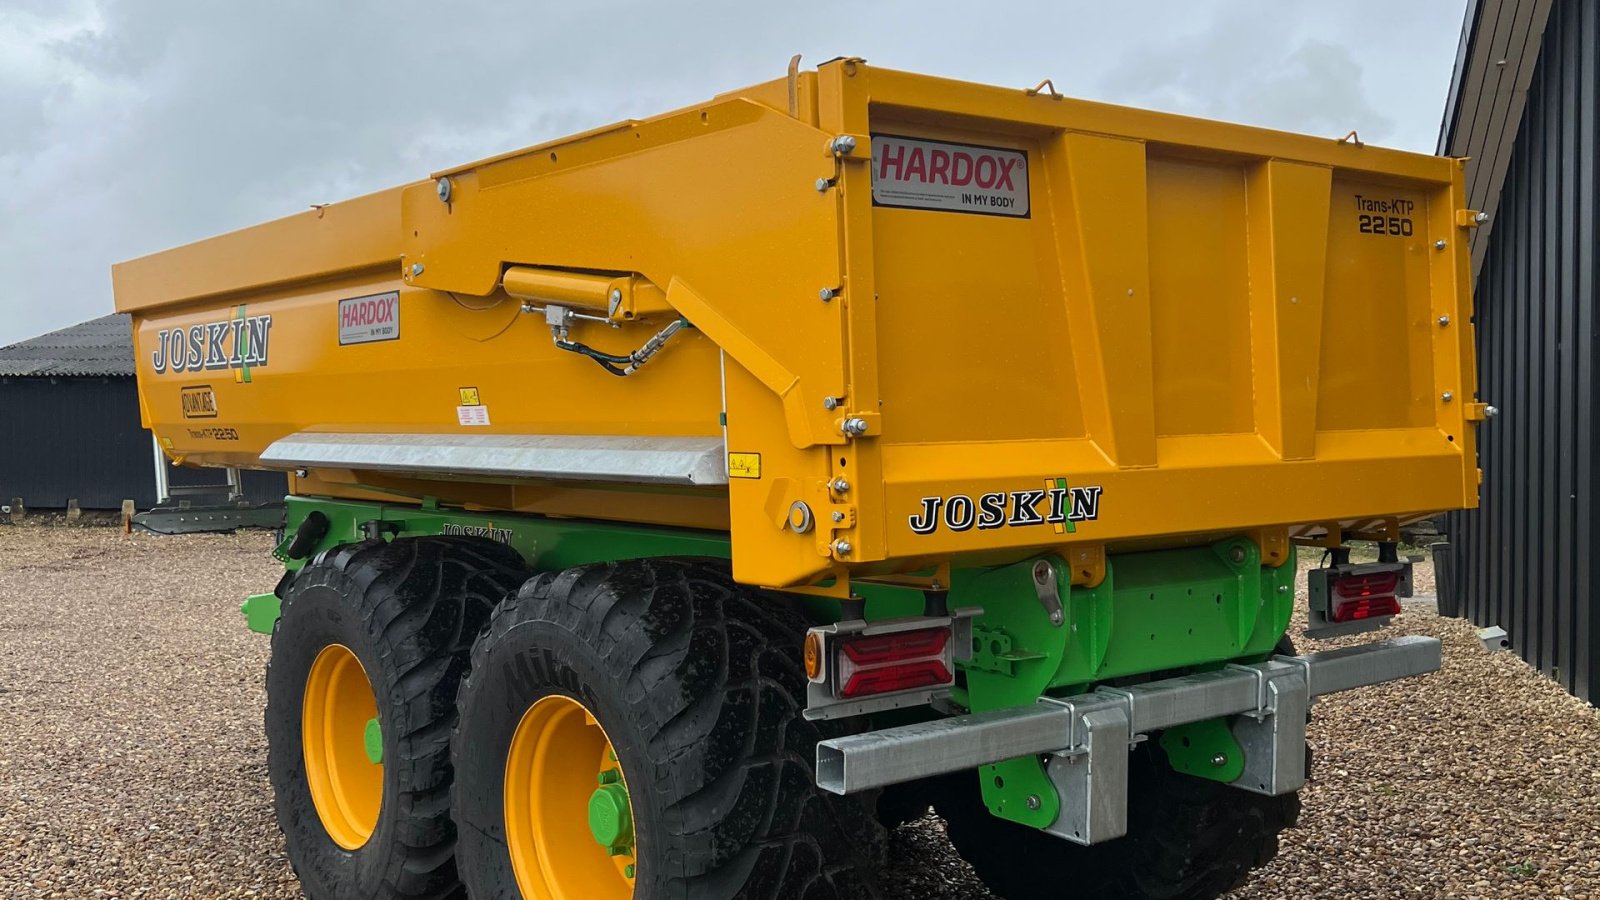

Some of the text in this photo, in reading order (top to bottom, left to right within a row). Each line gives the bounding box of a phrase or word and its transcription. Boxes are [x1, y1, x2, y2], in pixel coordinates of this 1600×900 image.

[961, 193, 972, 205] IN
[974, 194, 989, 206] MY
[990, 196, 1016, 208] BODY
[1354, 194, 1414, 215] Trans-KTP
[152, 314, 273, 373] JOSKIN
[181, 391, 214, 417] ADVANTAGE
[909, 485, 1102, 535] JOSKIN
